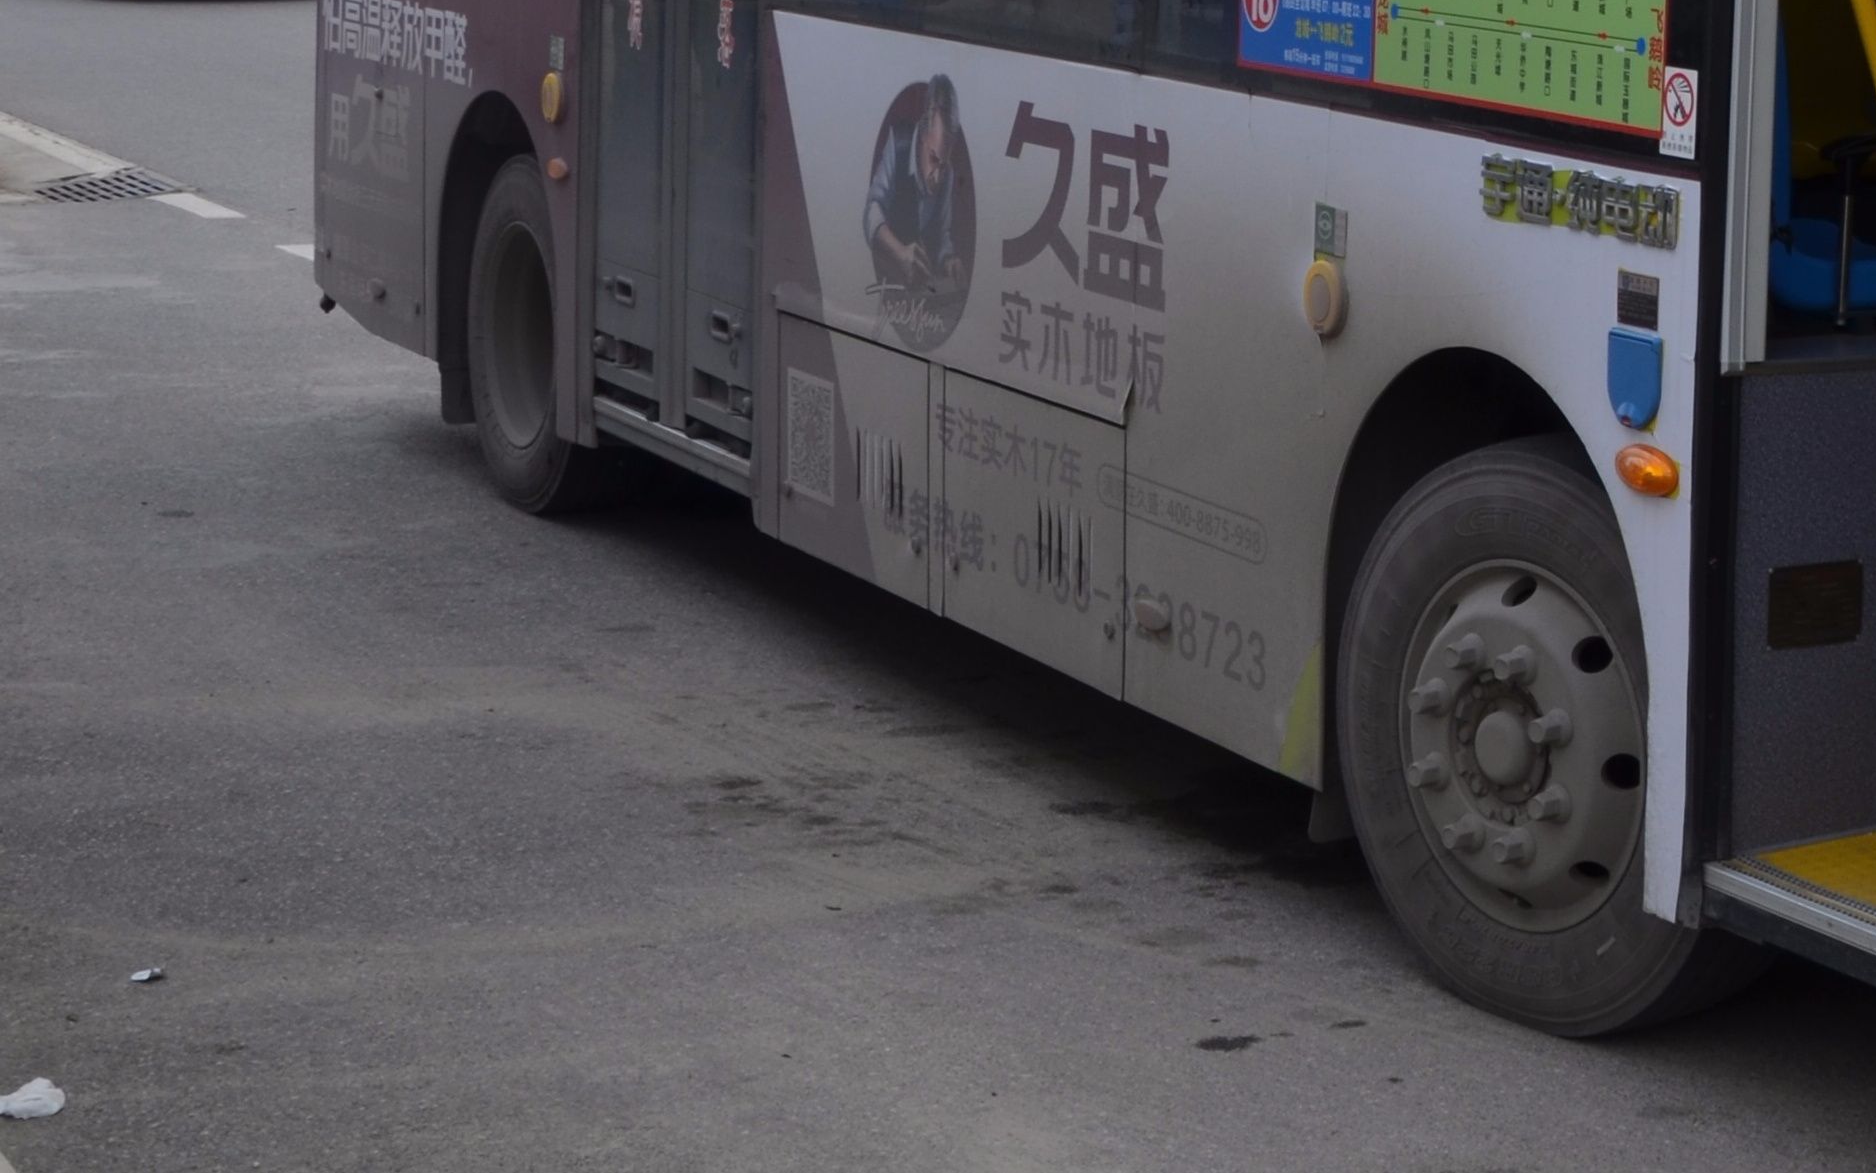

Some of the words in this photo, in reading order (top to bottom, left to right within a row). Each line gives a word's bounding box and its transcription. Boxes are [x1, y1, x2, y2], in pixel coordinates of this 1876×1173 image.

[1000, 100, 1170, 313] 久盛
[998, 289, 1168, 416] 实木地板
[936, 402, 1083, 493] 专注实木17年
